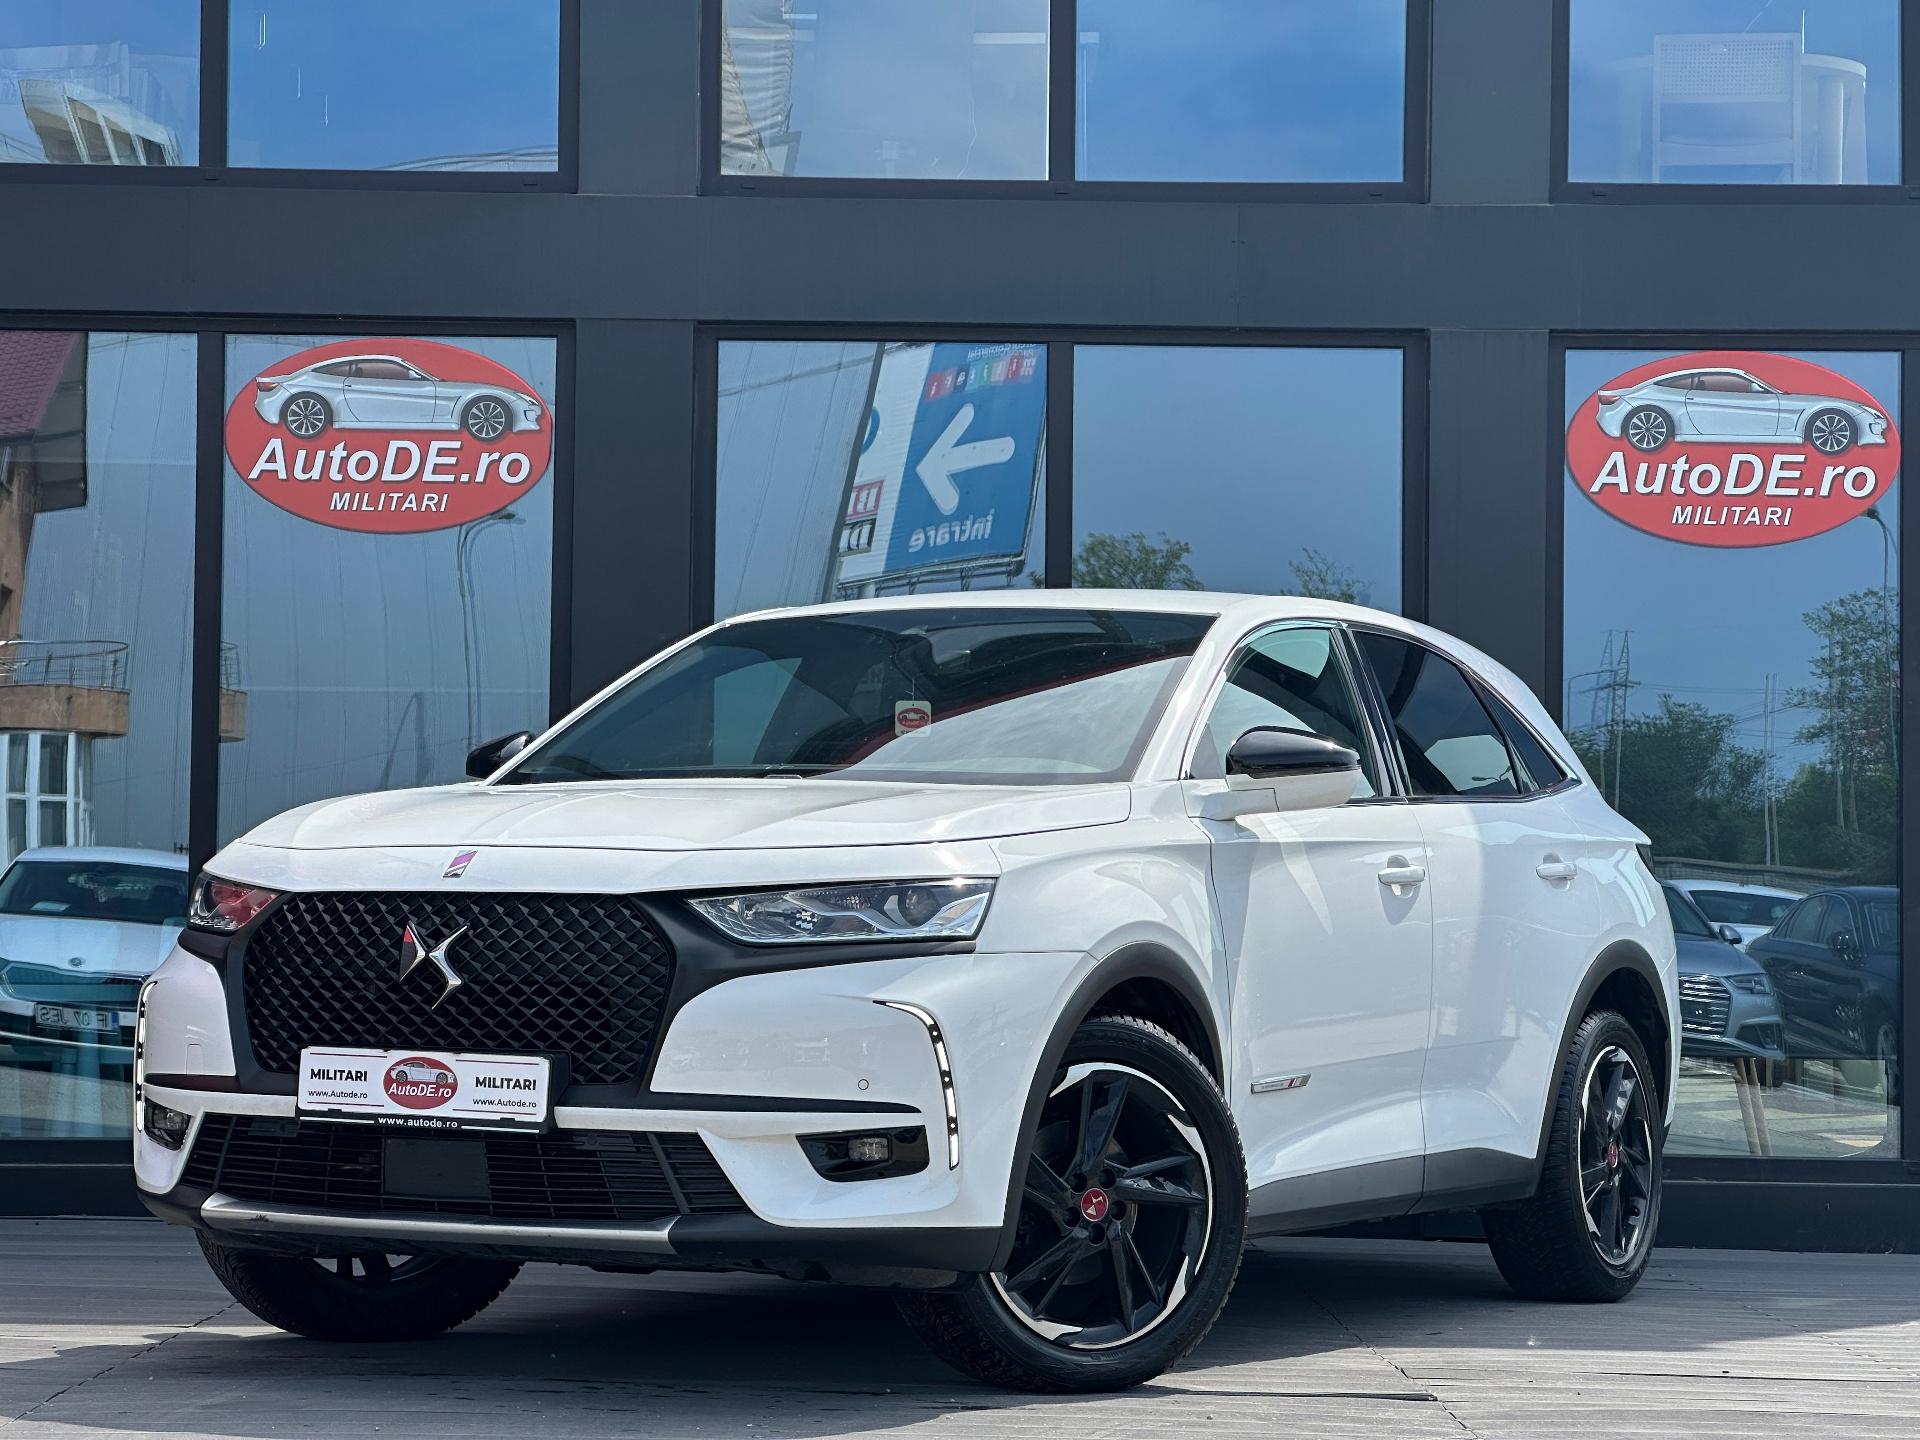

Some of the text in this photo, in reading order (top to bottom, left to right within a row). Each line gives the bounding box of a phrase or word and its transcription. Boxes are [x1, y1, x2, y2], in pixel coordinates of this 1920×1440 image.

[248, 438, 531, 484] AutoDE.ro
[1590, 451, 1877, 498] AutoDE.ro
[330, 492, 449, 512] MILITARI
[1671, 505, 1792, 526] MILITARI
[310, 1068, 368, 1082] MILITARI
[388, 1082, 452, 1098] AutoDE.ro
[475, 1076, 537, 1091] MILITARI
[308, 1089, 368, 1099] www.Autode.ro
[472, 1097, 537, 1108] www.Autode.ro
[378, 1116, 458, 1128] www.autode.ro
